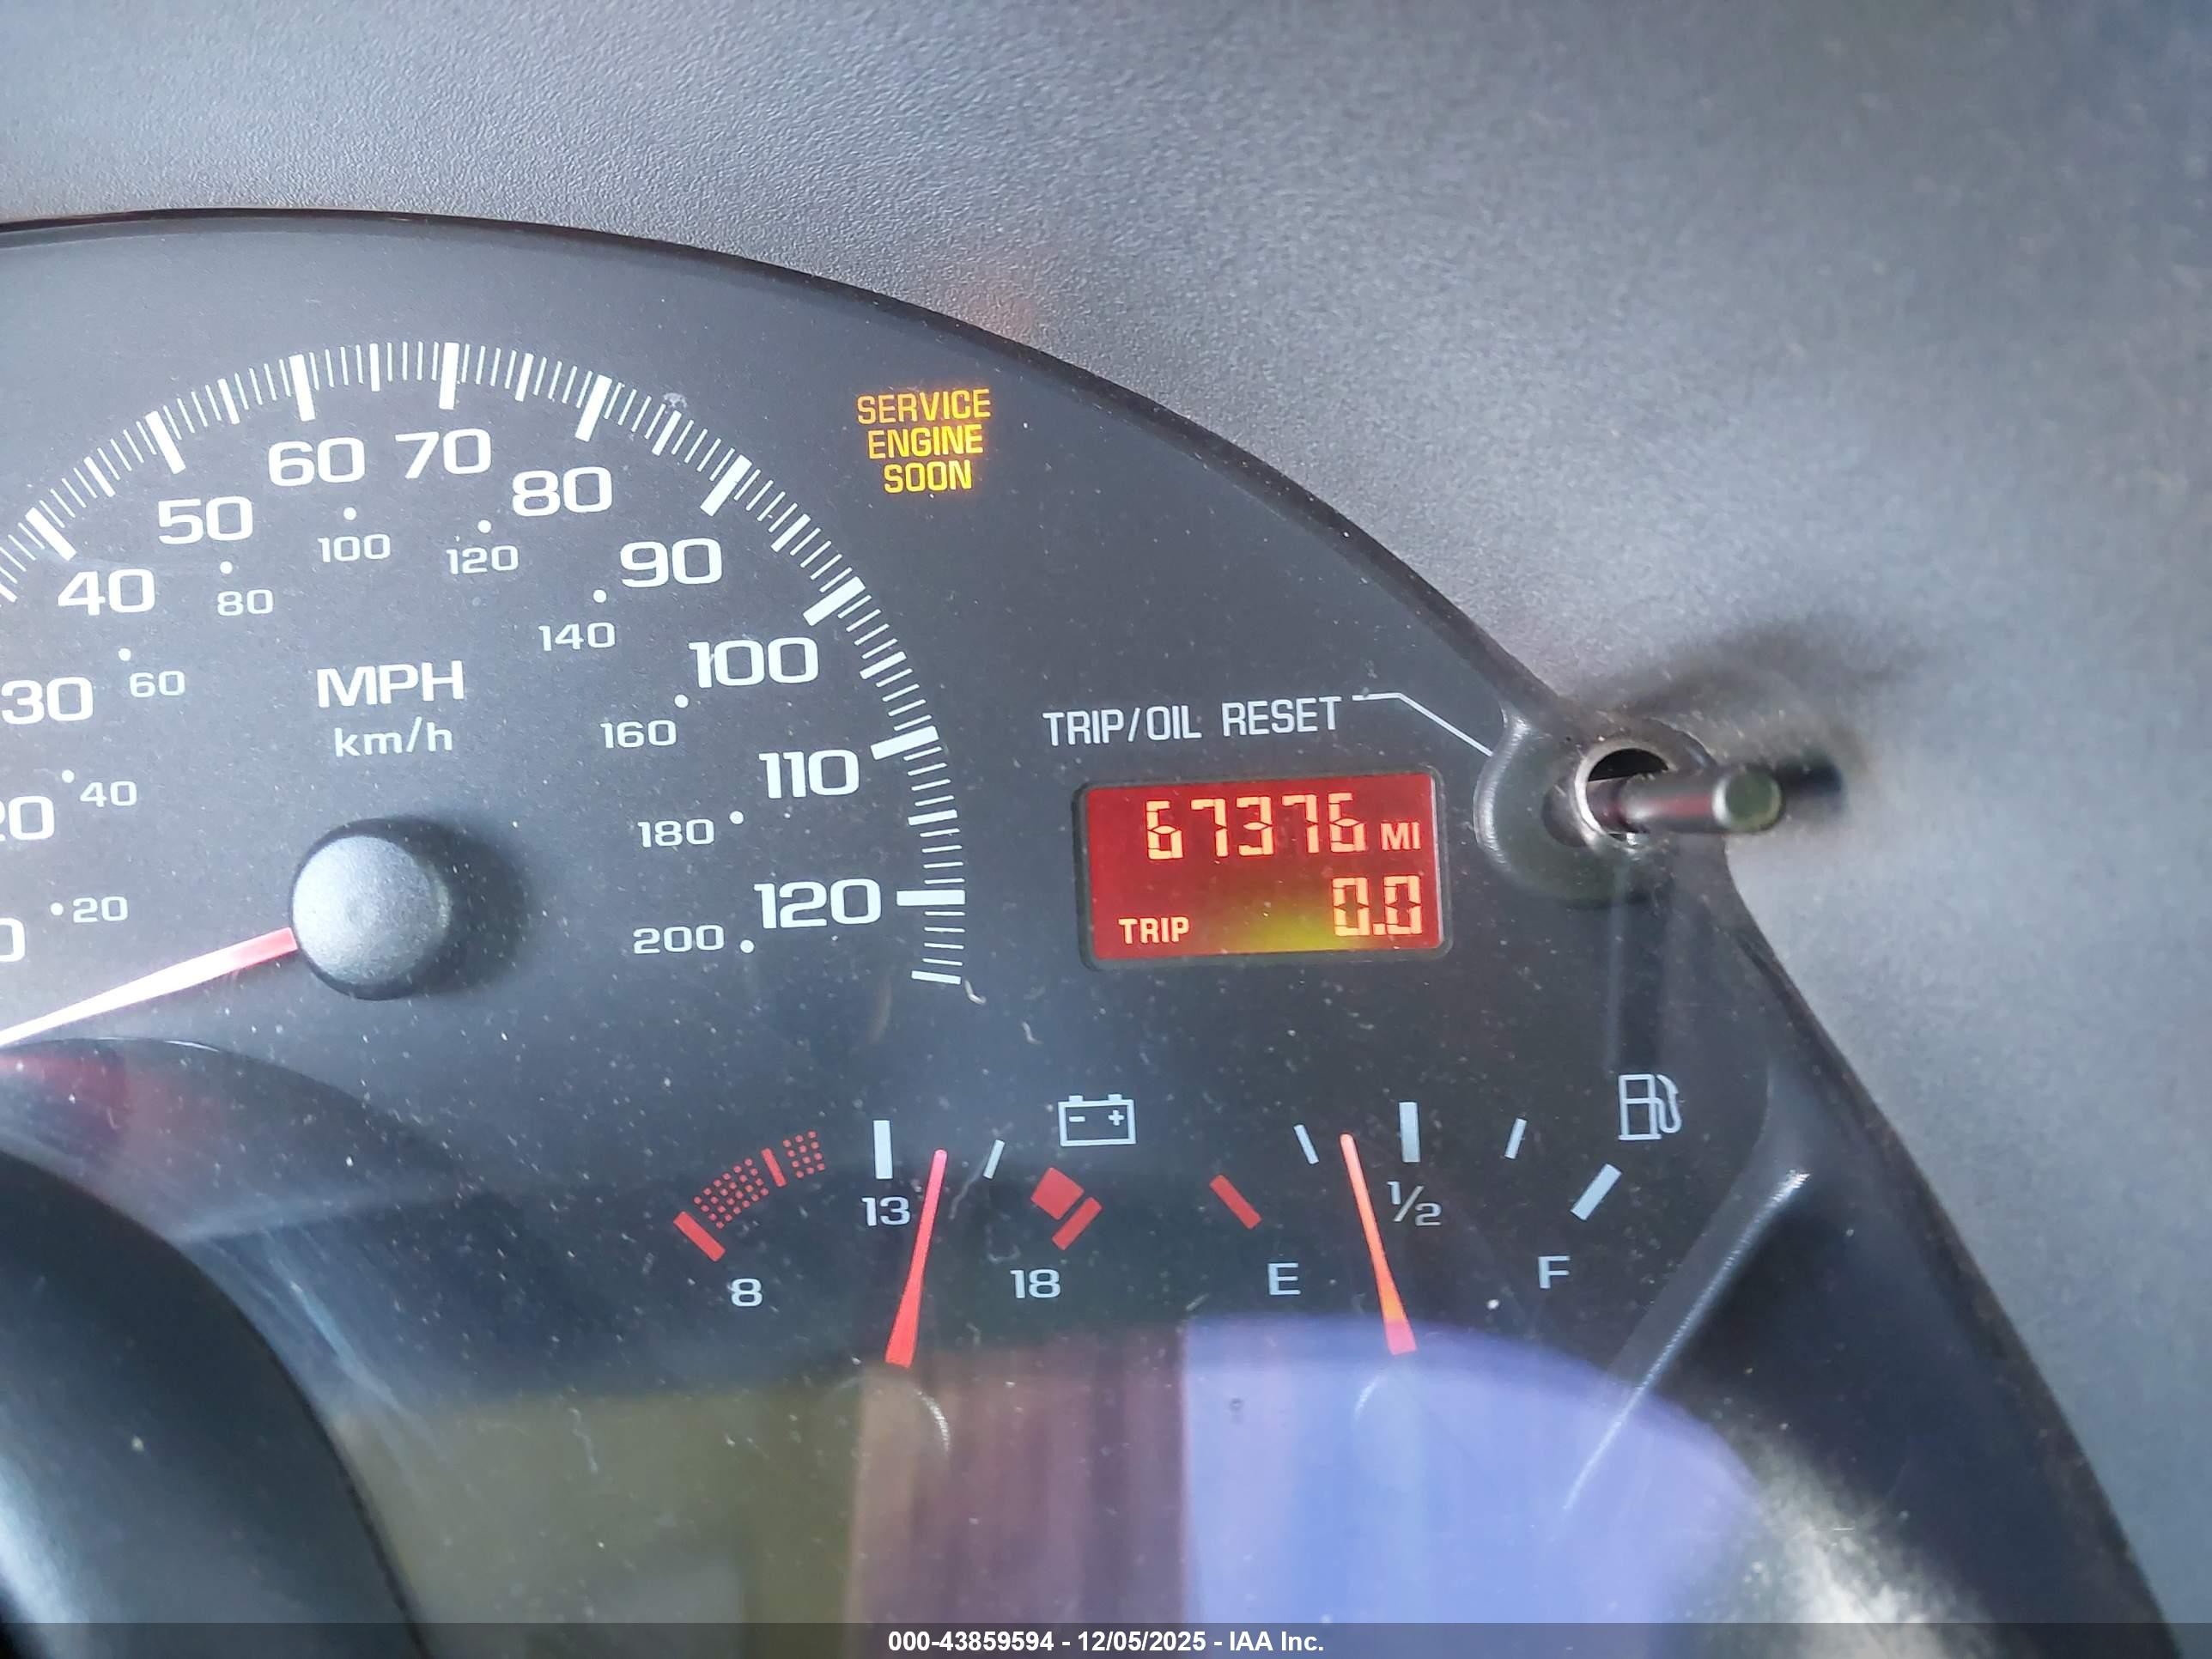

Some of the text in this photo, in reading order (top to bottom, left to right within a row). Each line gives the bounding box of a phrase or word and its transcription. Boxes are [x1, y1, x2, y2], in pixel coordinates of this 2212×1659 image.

[857, 389, 991, 423] SERVICE
[395, 428, 491, 477] 70
[867, 424, 983, 458] ENGINE
[268, 437, 366, 485] 60
[884, 459, 972, 492] SOON
[512, 466, 612, 515] 80
[158, 495, 253, 544] 50
[317, 533, 391, 561] 100
[446, 544, 520, 574] 120
[620, 538, 722, 586] 90
[58, 568, 155, 615] 40
[217, 589, 274, 615] 80
[538, 622, 616, 649] 140
[689, 637, 819, 686] 100
[1, 677, 94, 723] 30
[129, 671, 185, 696] 60
[316, 660, 465, 706] MPH
[335, 716, 453, 756] km/h
[601, 720, 677, 747] 160
[1042, 696, 1341, 744] TRIP/OIL RESET
[759, 749, 859, 797] 110
[80, 781, 137, 805] 40
[0, 795, 55, 841] 0
[638, 818, 714, 846] 180
[1146, 792, 1420, 859] 67376 MI
[72, 896, 129, 921] 20
[754, 878, 881, 927] 120
[1118, 875, 1423, 943] TRIP 0.0
[633, 925, 724, 952] 200
[861, 1196, 911, 1225] 13
[1010, 1268, 1061, 1297] 18
[1267, 1262, 1301, 1294] E
[1538, 1255, 1571, 1287] F
[731, 1278, 763, 1305] 8
